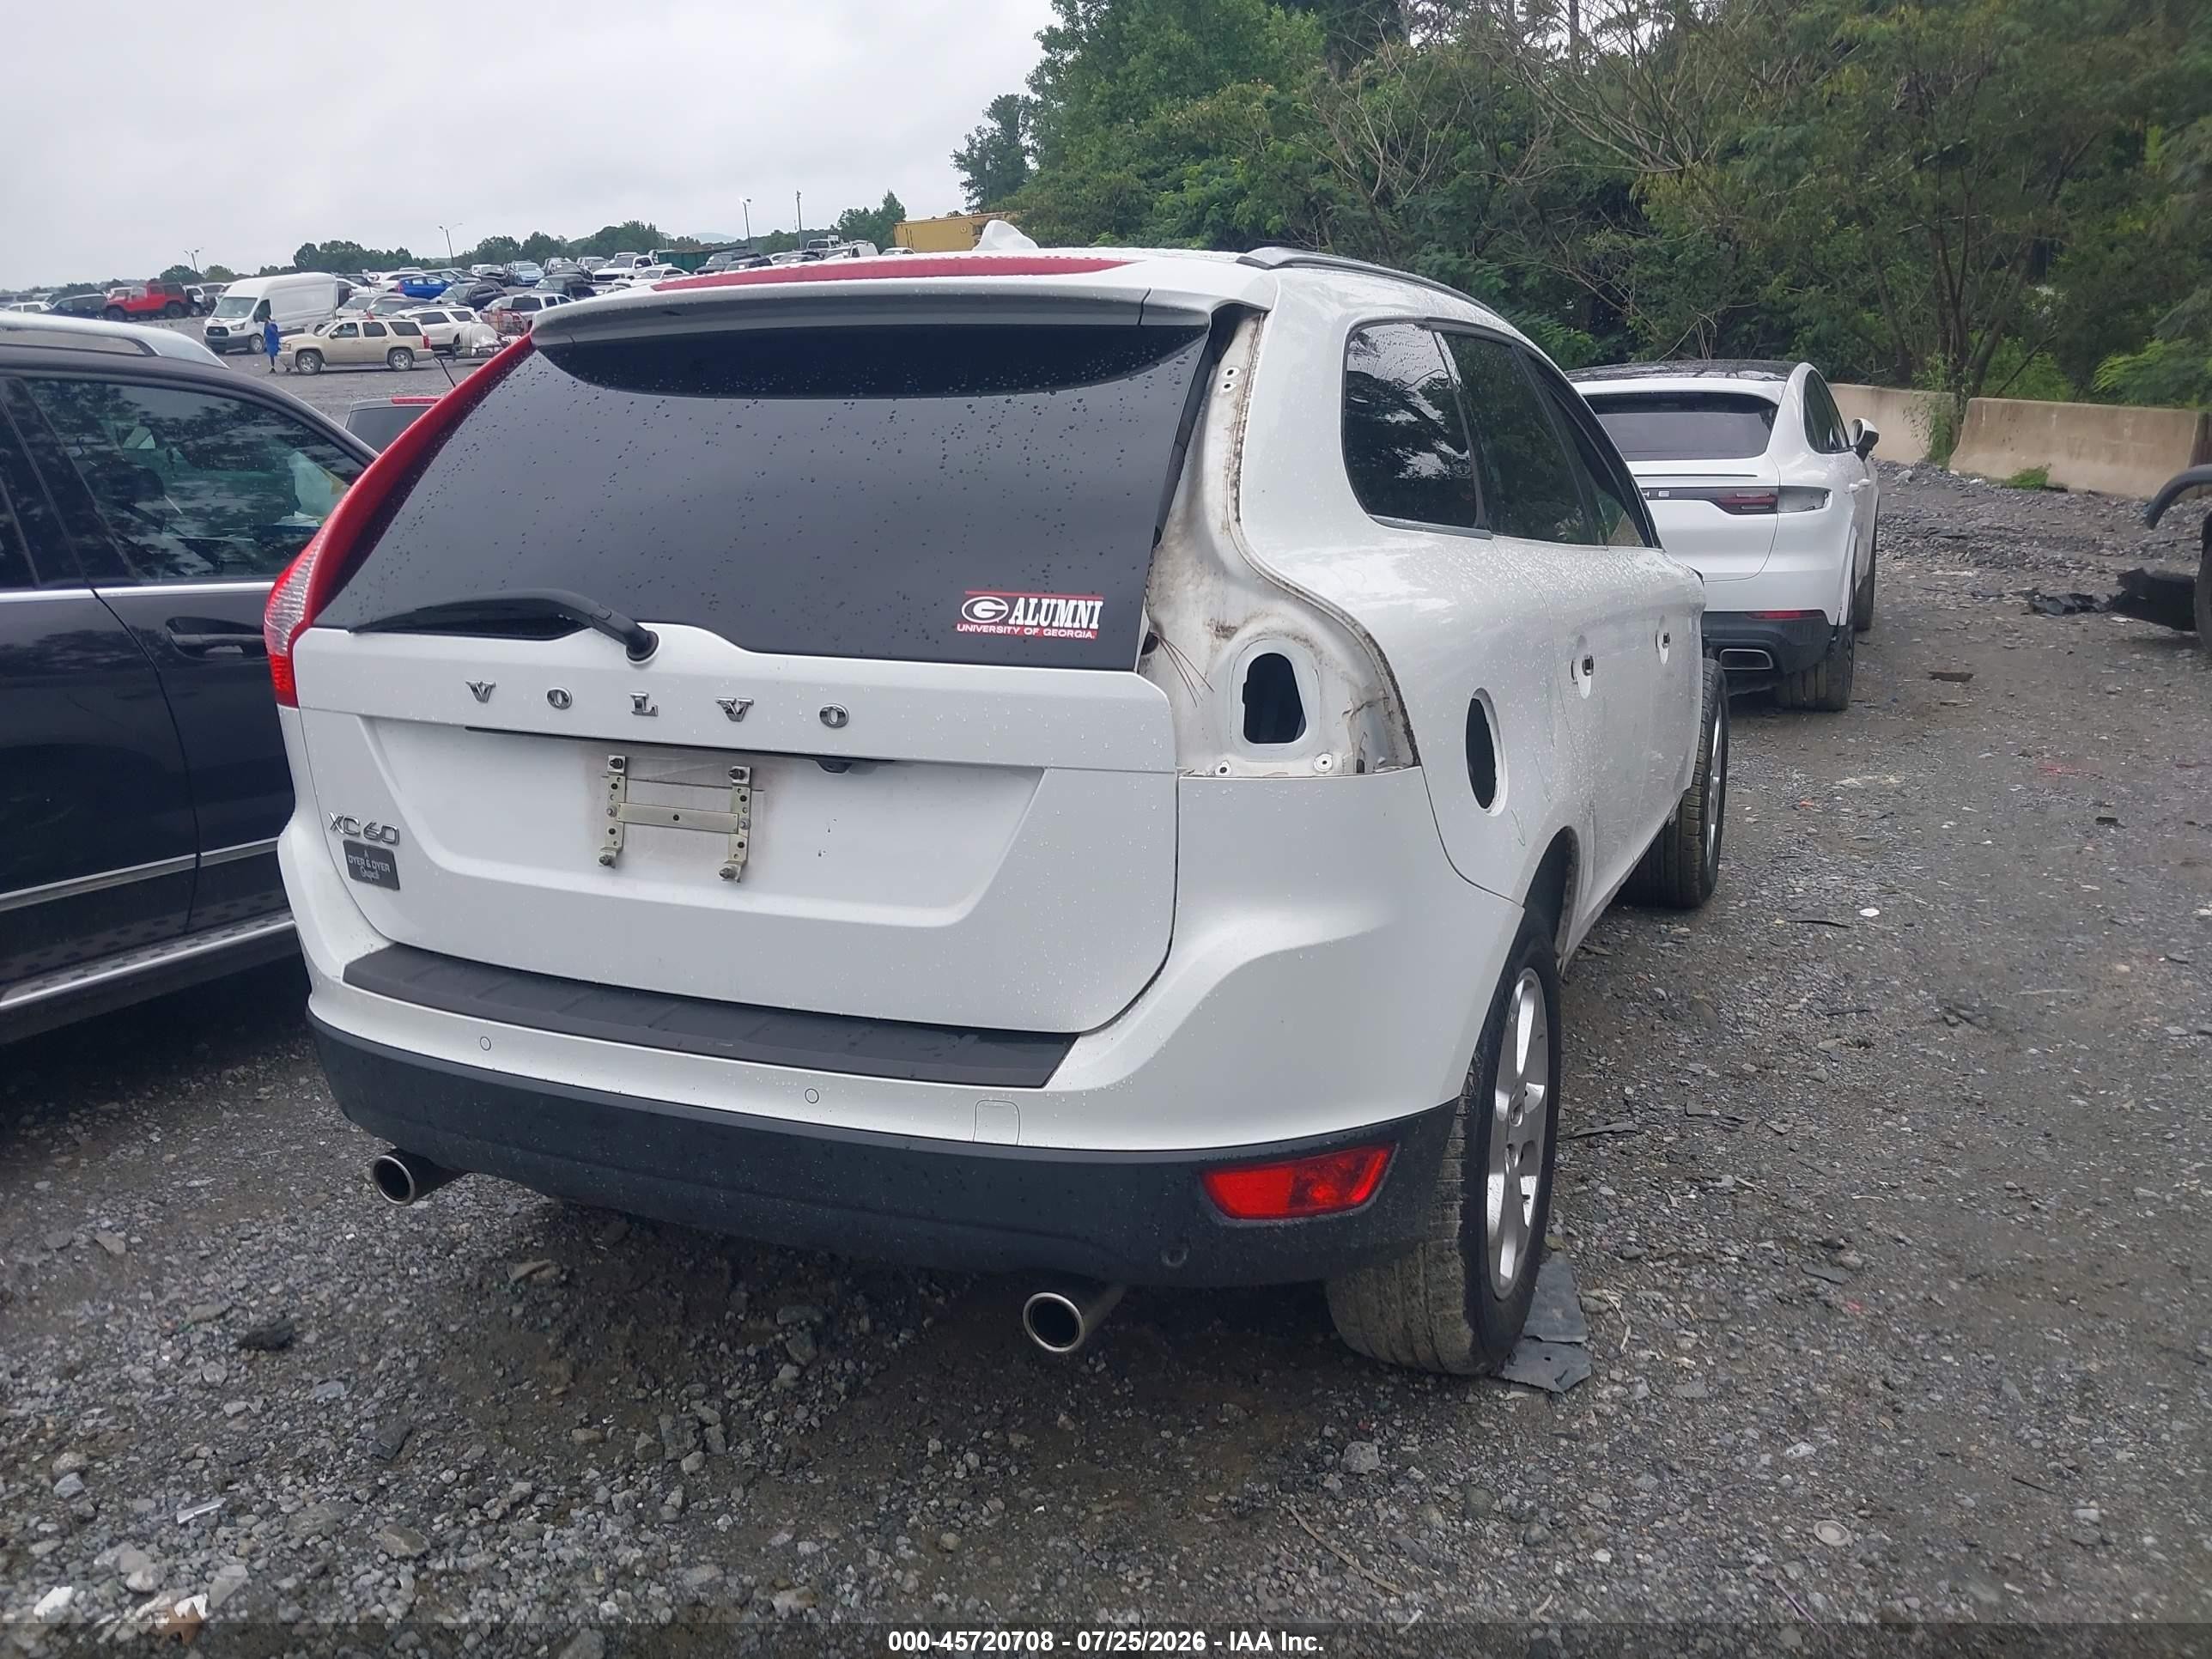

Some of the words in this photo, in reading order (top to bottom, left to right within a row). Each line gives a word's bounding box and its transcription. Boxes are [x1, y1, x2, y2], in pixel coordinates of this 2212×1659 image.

[957, 623, 1021, 635] UNIVERSITY
[1024, 628, 1039, 636] OF
[1008, 597, 1103, 630] ALUMNI
[465, 680, 849, 729] VOLVO
